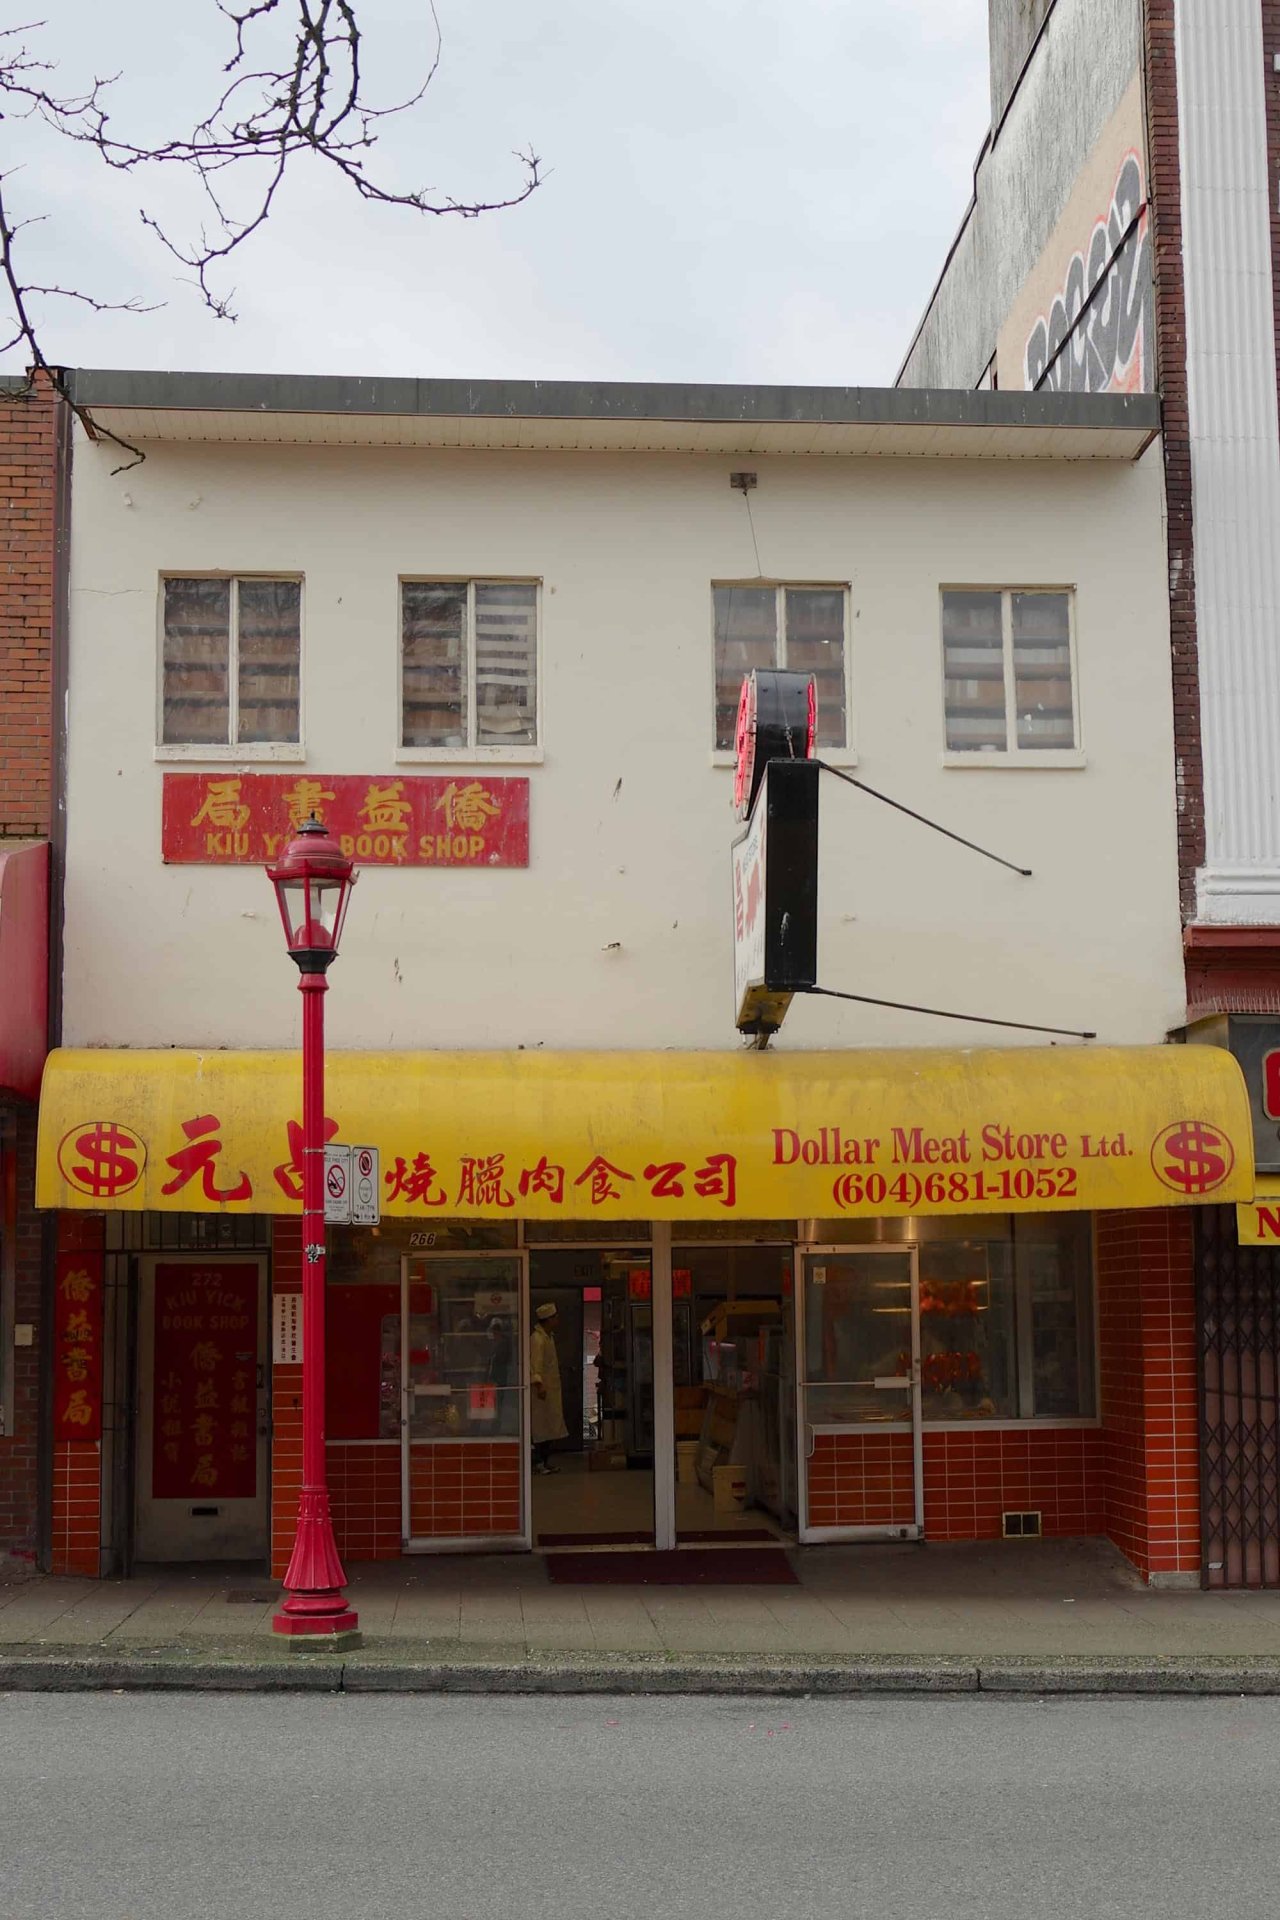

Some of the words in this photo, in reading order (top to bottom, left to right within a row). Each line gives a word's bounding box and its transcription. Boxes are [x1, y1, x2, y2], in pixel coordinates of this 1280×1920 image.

[206, 832, 249, 855] KIU
[340, 834, 408, 857] BOOK
[419, 836, 485, 859] SHOP
[771, 1126, 881, 1166] Dollar
[890, 1127, 973, 1165] Meat
[981, 1123, 1068, 1162] Store
[1081, 1132, 1134, 1158] Ltd.
[832, 1166, 1078, 1209] (604)681-1052
[410, 1232, 435, 1247] 266
[162, 1315, 203, 1330] BOOK
[209, 1315, 249, 1330] SHOP
